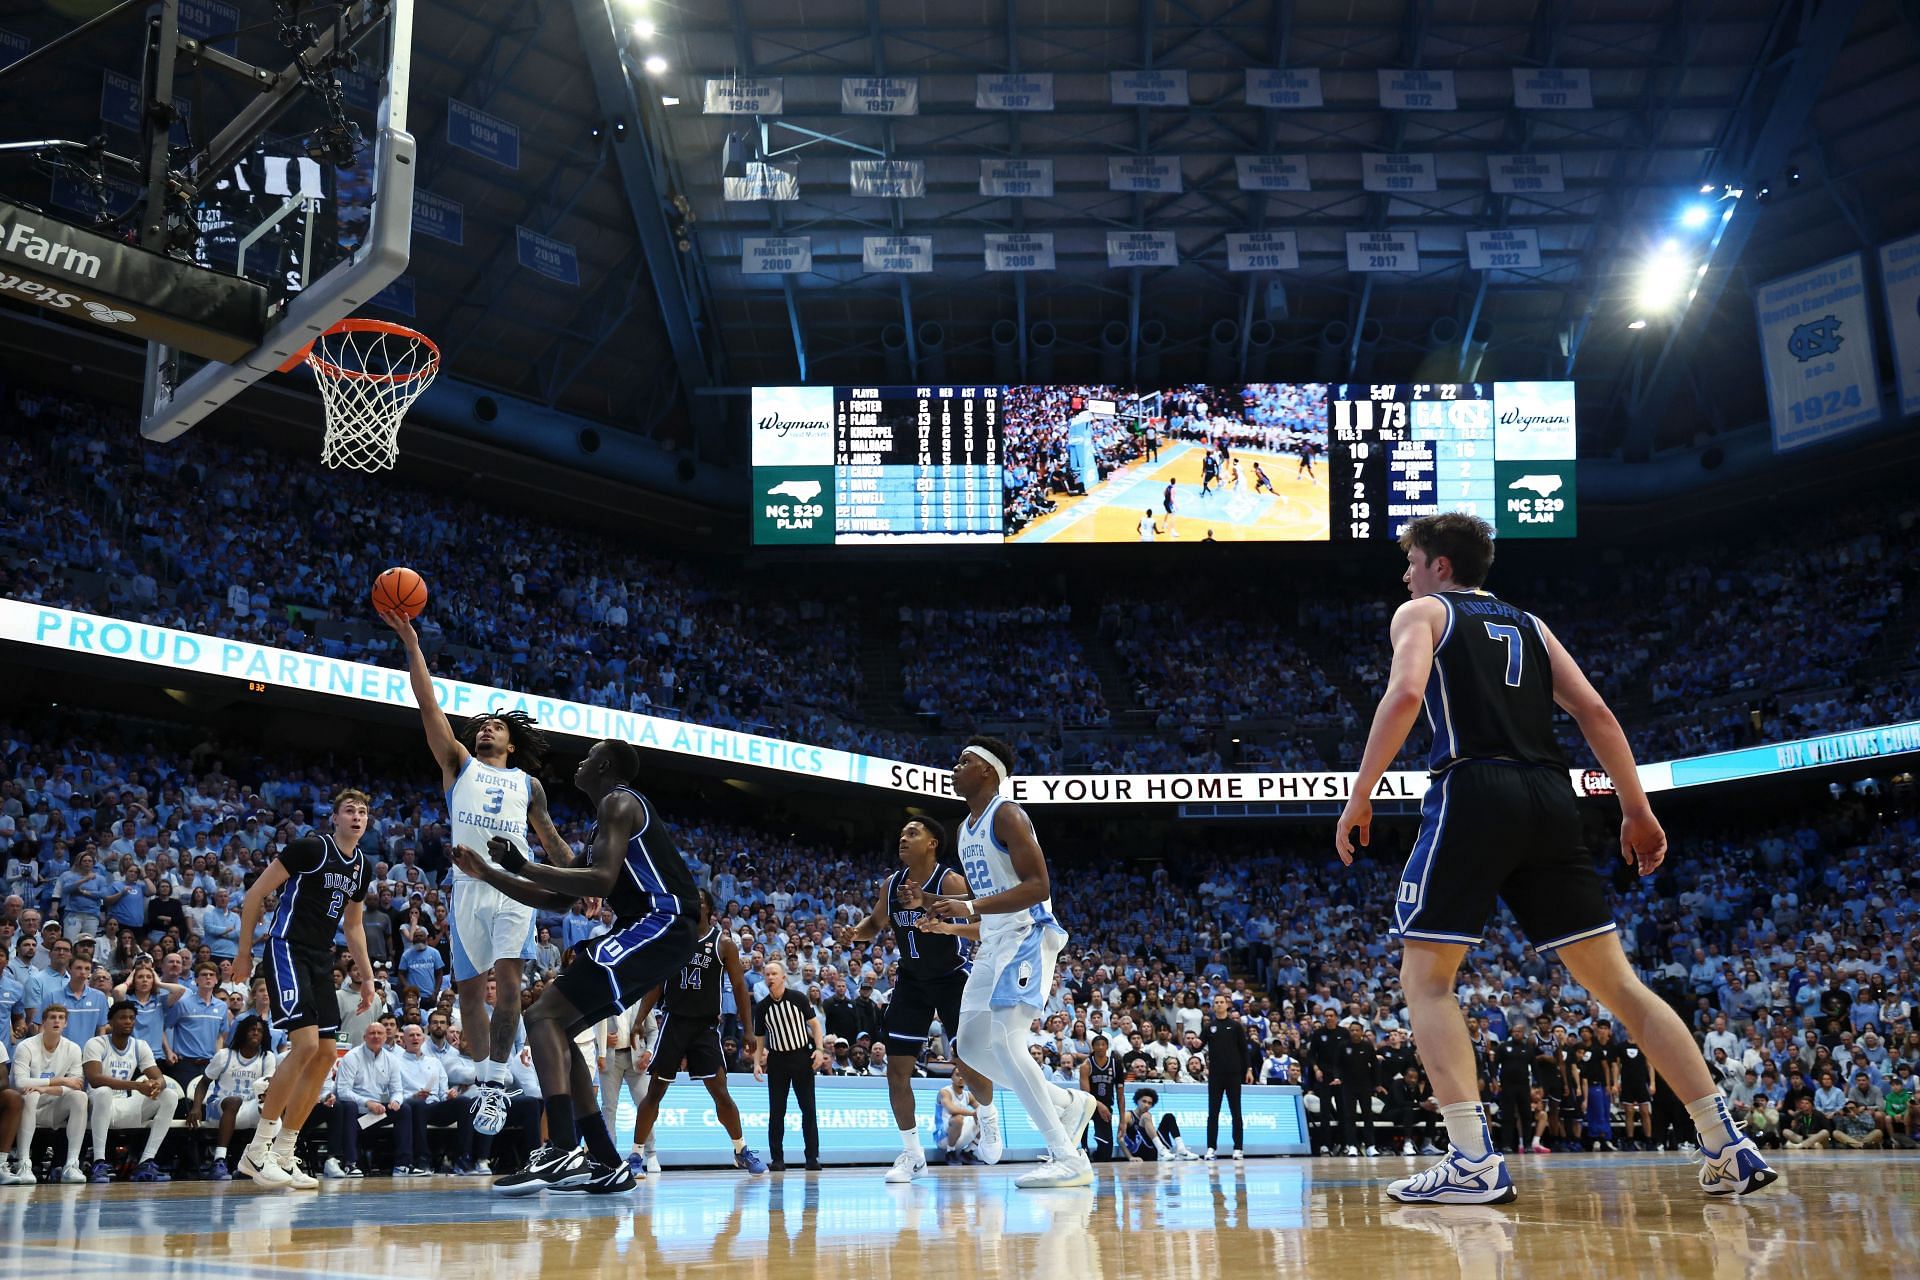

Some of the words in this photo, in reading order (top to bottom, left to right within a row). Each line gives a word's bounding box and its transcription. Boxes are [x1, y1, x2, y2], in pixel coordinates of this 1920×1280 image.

[1001, 96, 1030, 106] 1967
[1405, 94, 1432, 105] 1972
[1540, 93, 1566, 104] 1977
[729, 101, 759, 111] 1946
[867, 101, 896, 111] 1957
[470, 123, 498, 144] 1994
[1004, 182, 1031, 192] 1991
[1386, 177, 1414, 188] 1997
[6, 223, 101, 278] Farm
[1021, 243, 1042, 251] FOUR
[1006, 256, 1035, 266] 2008
[1128, 251, 1159, 261] 2009
[1249, 255, 1278, 266] 2016
[1370, 256, 1397, 267] 2017
[1491, 254, 1520, 265] 2022
[762, 260, 791, 270] 2000
[884, 258, 913, 269] 2005
[1765, 271, 1837, 304] University
[1761, 303, 1801, 325] North
[1802, 284, 1861, 312] Carolina
[917, 387, 931, 398] PTS
[961, 387, 975, 398] AST
[984, 387, 997, 398] FLS
[1440, 384, 1456, 400] 22
[840, 400, 845, 412] 1
[850, 400, 882, 412] FOSTER
[920, 400, 928, 412] 2
[943, 400, 949, 412] 1
[964, 400, 973, 412] 0
[987, 400, 995, 412] 0
[1790, 384, 1861, 424] 1924
[838, 414, 846, 426] 2
[918, 413, 931, 425] 13
[942, 413, 951, 425] 8
[964, 413, 973, 425] 5
[987, 413, 995, 425] 3
[1381, 402, 1406, 428] 73
[1417, 402, 1442, 428] 64
[1500, 406, 1569, 432] Wegmans
[757, 412, 830, 437] Wegmans
[839, 427, 846, 438] 7
[918, 426, 930, 438] 17
[942, 426, 951, 438] 2
[964, 426, 973, 438] 3
[988, 426, 993, 438] 1
[1356, 430, 1362, 441] 3
[1398, 430, 1404, 441] 2
[838, 440, 846, 451] 9
[920, 439, 929, 451] 2
[942, 439, 951, 451] 9
[964, 439, 973, 451] 0
[987, 439, 996, 451] 0
[1349, 443, 1369, 459] 10
[837, 454, 848, 465] 14
[918, 452, 931, 465] 14
[942, 452, 951, 465] 5
[966, 452, 972, 465] 1
[987, 452, 995, 465] 2
[920, 465, 928, 478] 7
[1354, 463, 1364, 479] 7
[839, 479, 847, 491] 4
[917, 478, 932, 491] 20
[945, 478, 950, 491] 1
[989, 478, 994, 491] 1
[1354, 482, 1365, 499] 2
[1460, 482, 1471, 497] 7
[921, 491, 929, 504] 7
[989, 491, 994, 504] 1
[765, 505, 790, 518] NC
[793, 504, 824, 518] 529
[987, 504, 996, 517] 0
[1350, 502, 1370, 518] 13
[1507, 499, 1532, 512] NC
[1535, 498, 1564, 512] 529
[776, 518, 813, 529] PLAN
[921, 518, 929, 530] 7
[944, 518, 952, 530] 4
[967, 518, 972, 530] 1
[989, 518, 994, 530] 1
[1518, 512, 1554, 523] PLAN
[1350, 522, 1369, 538] 12
[1483, 620, 1523, 688] 7
[36, 610, 202, 666] PROUD
[221, 644, 406, 703] PARTNER
[433, 684, 471, 713] OF
[487, 691, 659, 746] CAROLINA
[672, 721, 824, 773] ATHLETICS
[1776, 744, 1805, 768] ROY
[1806, 733, 1880, 764] WILLIAMS
[1881, 727, 1920, 755] COUR
[475, 772, 518, 792] NORTH
[891, 765, 1028, 801] SCHEE
[1042, 779, 1132, 801] YOUR
[1147, 778, 1244, 800] HOME
[1258, 776, 1414, 798] PHYSIAL
[482, 787, 504, 815] 3
[458, 811, 520, 834] CAROLINA
[962, 844, 985, 860] NORTH
[964, 860, 993, 891] 22
[324, 872, 358, 896] DUKE
[326, 891, 344, 919] 2
[908, 930, 920, 958] 1
[690, 952, 712, 969] KE
[680, 966, 702, 990] 14
[231, 1070, 256, 1079] NORTH
[235, 1078, 251, 1094] 11
[658, 1108, 688, 1126] T&T
[817, 1109, 889, 1128] HANGES
